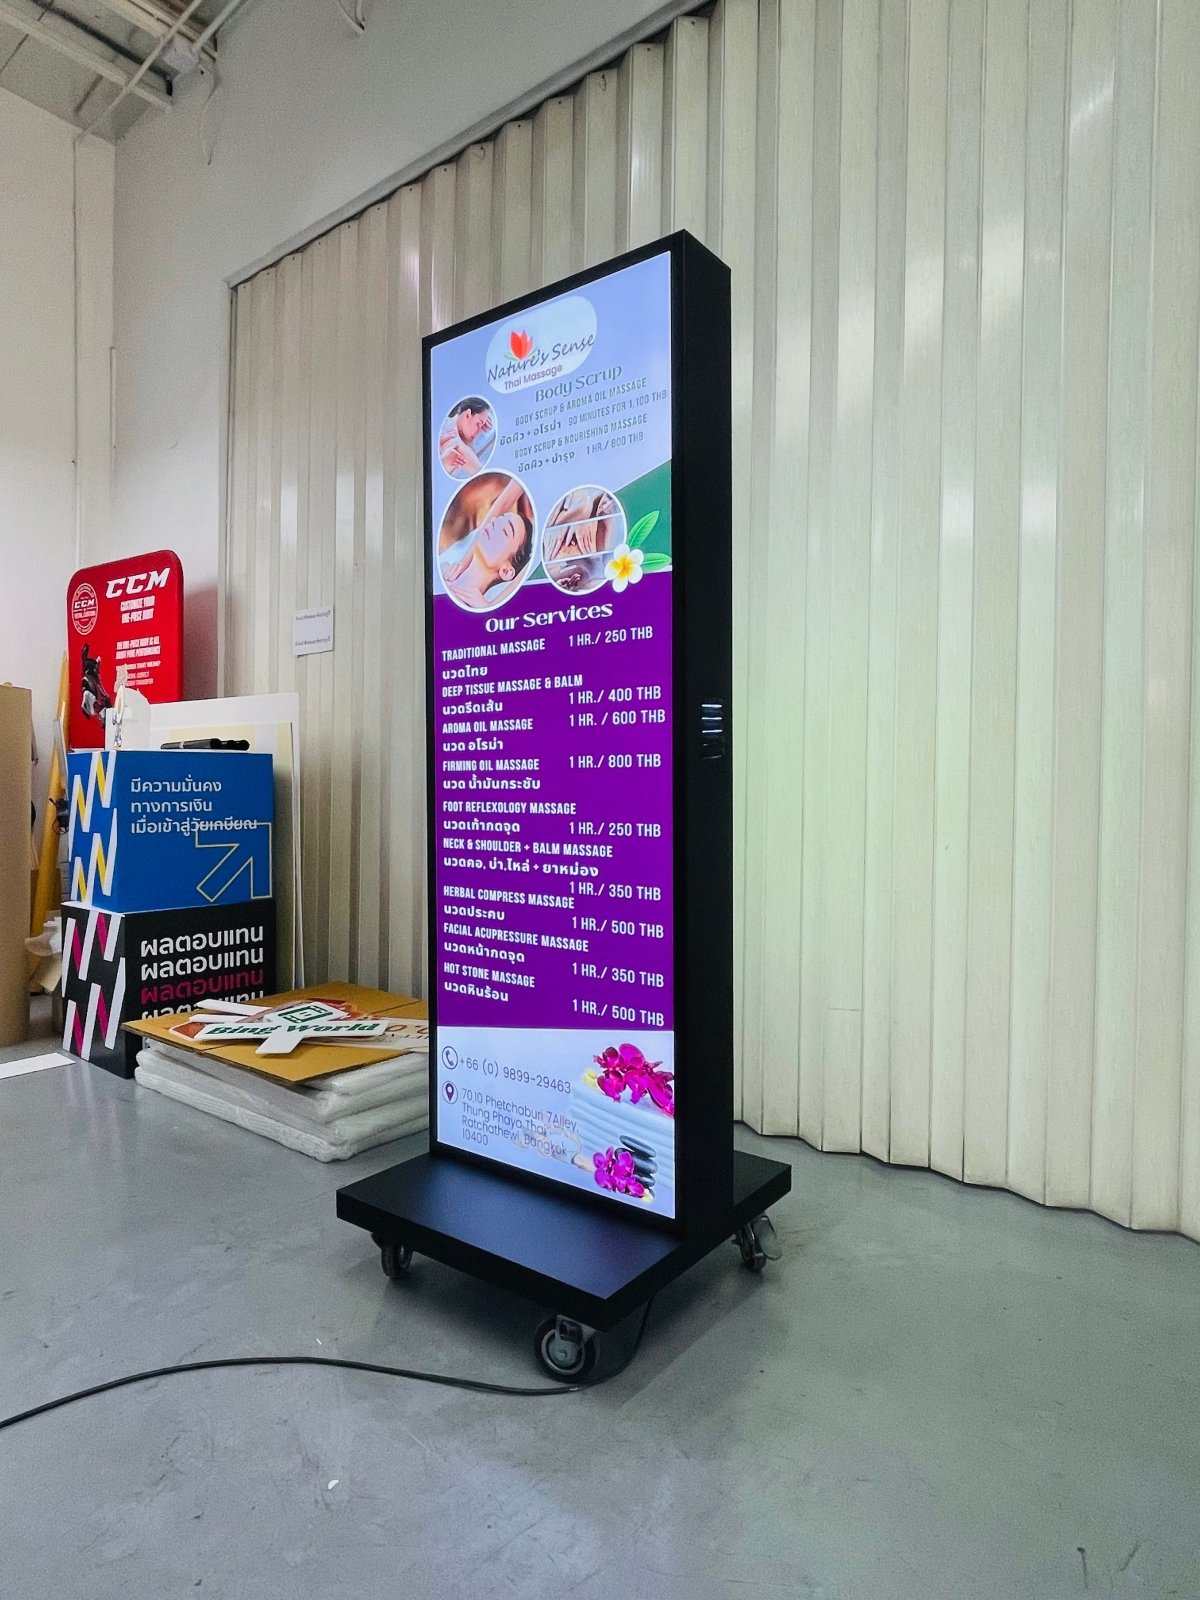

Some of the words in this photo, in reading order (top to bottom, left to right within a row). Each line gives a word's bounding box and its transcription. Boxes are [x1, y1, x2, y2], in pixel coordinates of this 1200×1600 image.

[488, 349, 550, 382] Nature's
[552, 334, 594, 360] Sense
[504, 377, 522, 390] Thai
[524, 364, 562, 384] Massage
[535, 382, 572, 402] Body
[576, 365, 622, 389] Scrup
[515, 412, 533, 426] BODY
[535, 405, 558, 420] SCRUP
[560, 404, 564, 412] &
[566, 394, 592, 411] AROMA
[594, 390, 606, 402] OIL
[608, 378, 646, 398] MASSAGE
[568, 416, 578, 426] 90
[580, 406, 610, 422] MINUTES
[612, 402, 626, 414] FOR
[630, 394, 649, 408] 1,100
[652, 390, 667, 402] THB
[500, 432, 524, 446] ขัดผิว
[514, 446, 532, 458] BODY
[534, 438, 556, 454] SCRUP
[558, 437, 562, 446] &
[564, 424, 608, 444] NOURISHING
[610, 413, 648, 432] MASSAGE
[586, 446, 590, 454] 1
[628, 432, 644, 444] THB
[518, 459, 542, 472] ขัดผิว
[105, 567, 171, 599] CCM
[74, 598, 95, 609] CCM
[485, 616, 520, 632] Our
[523, 603, 613, 628] Services
[568, 635, 574, 647] 1
[604, 628, 626, 644] 250
[630, 626, 653, 640] THB
[442, 645, 498, 662] TRADITIONAL
[500, 638, 546, 654] MASSAGE
[442, 664, 488, 680] นวดไทย
[442, 685, 463, 698] DEEP
[465, 682, 495, 696] TISSUE
[498, 678, 542, 693] MASSAGE
[544, 677, 552, 688] &
[554, 674, 583, 688] BALM
[568, 692, 574, 704] 1
[608, 688, 632, 702] 400
[636, 686, 662, 700] THB
[442, 698, 503, 715] นวดรีดเส้น
[442, 722, 472, 734] AROMA
[474, 721, 488, 732] OIL
[490, 718, 534, 732] MASSAGE
[568, 714, 574, 727] 1
[578, 713, 597, 726] HR.
[612, 710, 637, 725] 600
[640, 708, 666, 724] THB
[442, 742, 466, 752] นวด
[468, 737, 504, 750] อโรม่า
[442, 760, 477, 772] FIRMING
[478, 759, 494, 771] OIL
[496, 758, 540, 770] MASSAGE
[568, 756, 574, 768] 1
[608, 754, 632, 768] 800
[636, 754, 662, 768] THB
[130, 774, 222, 792] มีความมั่นคง
[443, 780, 466, 790] นวด
[468, 774, 540, 790] น้ำมันกระชับ
[131, 798, 212, 813] ทางการเงิน
[442, 800, 463, 812] FOOT
[466, 801, 526, 814] REFLEXOLOGY
[530, 802, 576, 814] MASSAGE
[443, 818, 521, 836] นวดเท้ากดจุด
[568, 822, 574, 834] 1
[608, 822, 632, 836] 250
[636, 823, 662, 838] THB
[443, 838, 465, 850] NECK
[467, 838, 473, 850] &
[475, 839, 522, 852] SHOULDER
[532, 842, 560, 855] BALM
[563, 844, 613, 858] MASSAGE
[542, 861, 599, 876] ยาหม่อง
[444, 886, 476, 899] HERBAL
[478, 889, 526, 904] COMPRESS
[528, 894, 575, 910] MASSAGE
[569, 881, 574, 894] 1
[608, 884, 632, 898] 350
[636, 886, 662, 901] THB
[444, 904, 505, 920] นวดประคบ
[444, 922, 472, 936] FACIAL
[474, 926, 538, 946] ACUPRESSURE
[541, 936, 589, 952] MASSAGE
[572, 916, 577, 928] 1
[611, 920, 635, 936] 500
[639, 922, 664, 938] THB
[140, 926, 264, 958] ผลตอบแทน
[444, 942, 525, 964] นวดหน้ากดจุด
[140, 948, 264, 981] ผลตอบแทน
[444, 962, 460, 974] HOT
[462, 965, 490, 980] STONE
[492, 970, 536, 988] MASSAGE
[572, 962, 577, 974] 1
[611, 968, 635, 984] 350
[639, 970, 664, 988] THB
[140, 969, 264, 1004] ผลตอบแทน
[444, 982, 509, 1002] นวดหินร้อน
[572, 999, 578, 1012] 1
[612, 1005, 636, 1022] 500
[640, 1009, 664, 1026] THB
[206, 1024, 281, 1036] Bing
[286, 1023, 381, 1034] World
[460, 1057, 478, 1070] +66
[482, 1058, 499, 1078] (0)
[503, 1066, 571, 1094] 9899-29463
[462, 1102, 490, 1123] Thung
[492, 1111, 522, 1130] Phaya
[486, 1095, 544, 1120] Phetchaburi
[462, 1128, 488, 1146] 10400
[524, 1134, 567, 1157] Bangkok
